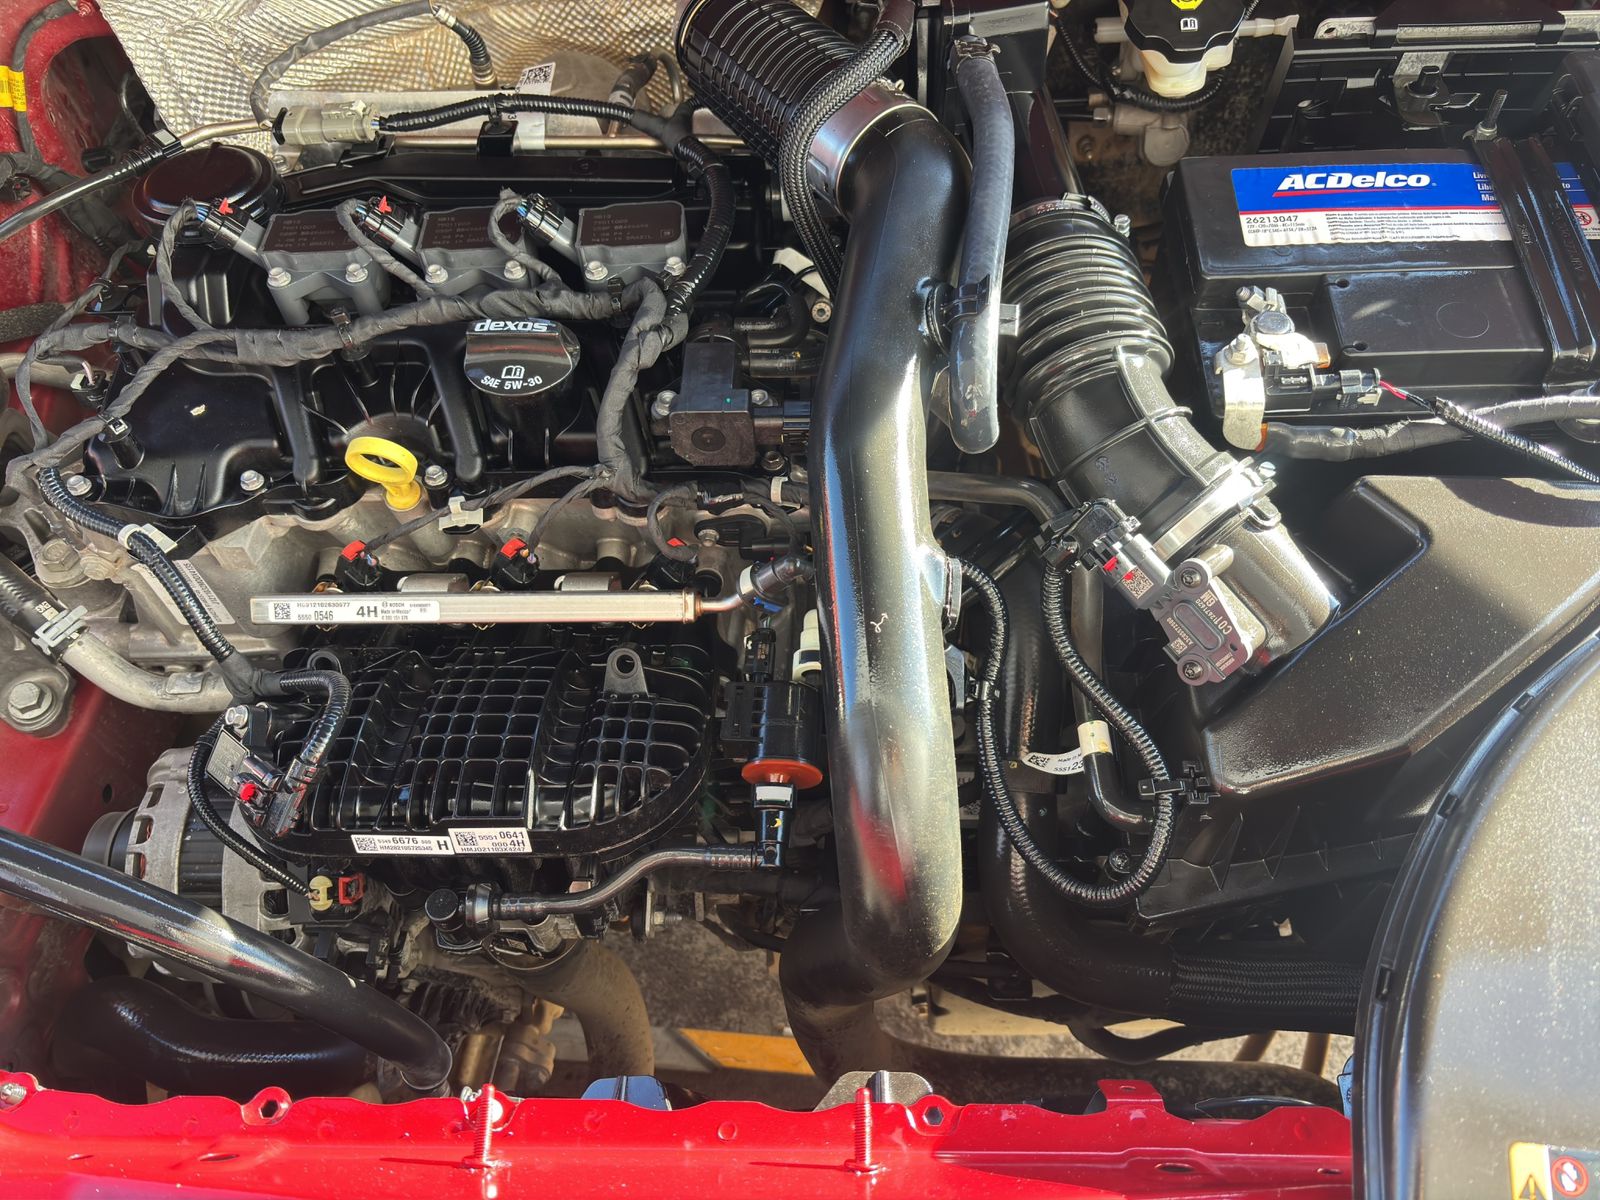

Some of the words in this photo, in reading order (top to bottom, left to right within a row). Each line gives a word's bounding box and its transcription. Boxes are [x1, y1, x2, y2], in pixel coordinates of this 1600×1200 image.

[1277, 172, 1430, 190] ACDelco
[1246, 215, 1299, 224] 26213047
[474, 319, 548, 332] dexos
[481, 375, 501, 388] SAE
[504, 376, 543, 390] 5W-30
[1200, 592, 1216, 607] GM
[314, 610, 334, 621] 0546
[356, 605, 378, 618] 4H
[1217, 616, 1233, 635] C01
[1071, 760, 1084, 771] 23
[392, 837, 419, 845] 6676
[499, 831, 525, 839] 0641
[437, 840, 449, 851] H
